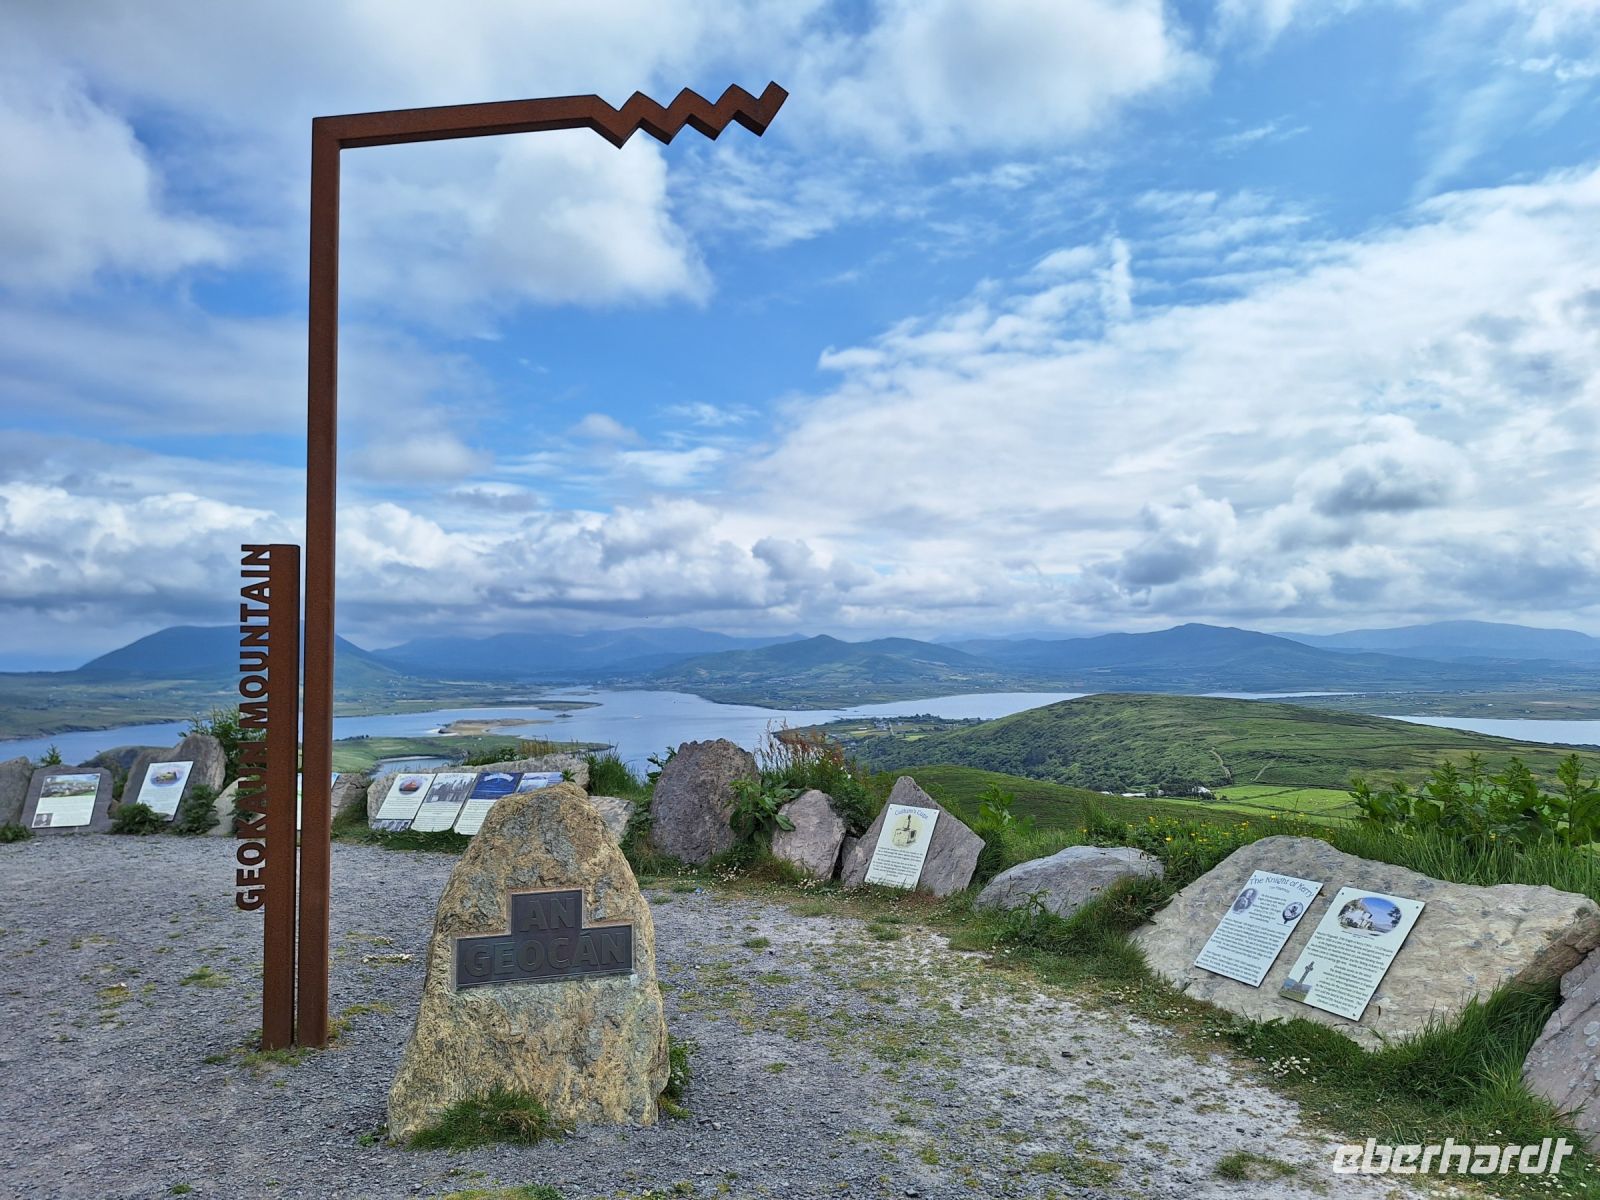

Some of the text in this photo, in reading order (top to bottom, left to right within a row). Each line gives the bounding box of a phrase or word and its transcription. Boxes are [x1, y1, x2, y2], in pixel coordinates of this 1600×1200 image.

[236, 544, 271, 911] GEOKAUN MOUNTAIN
[1265, 876, 1289, 885] Knight
[1297, 882, 1315, 898] Kerry
[518, 897, 574, 932] AN
